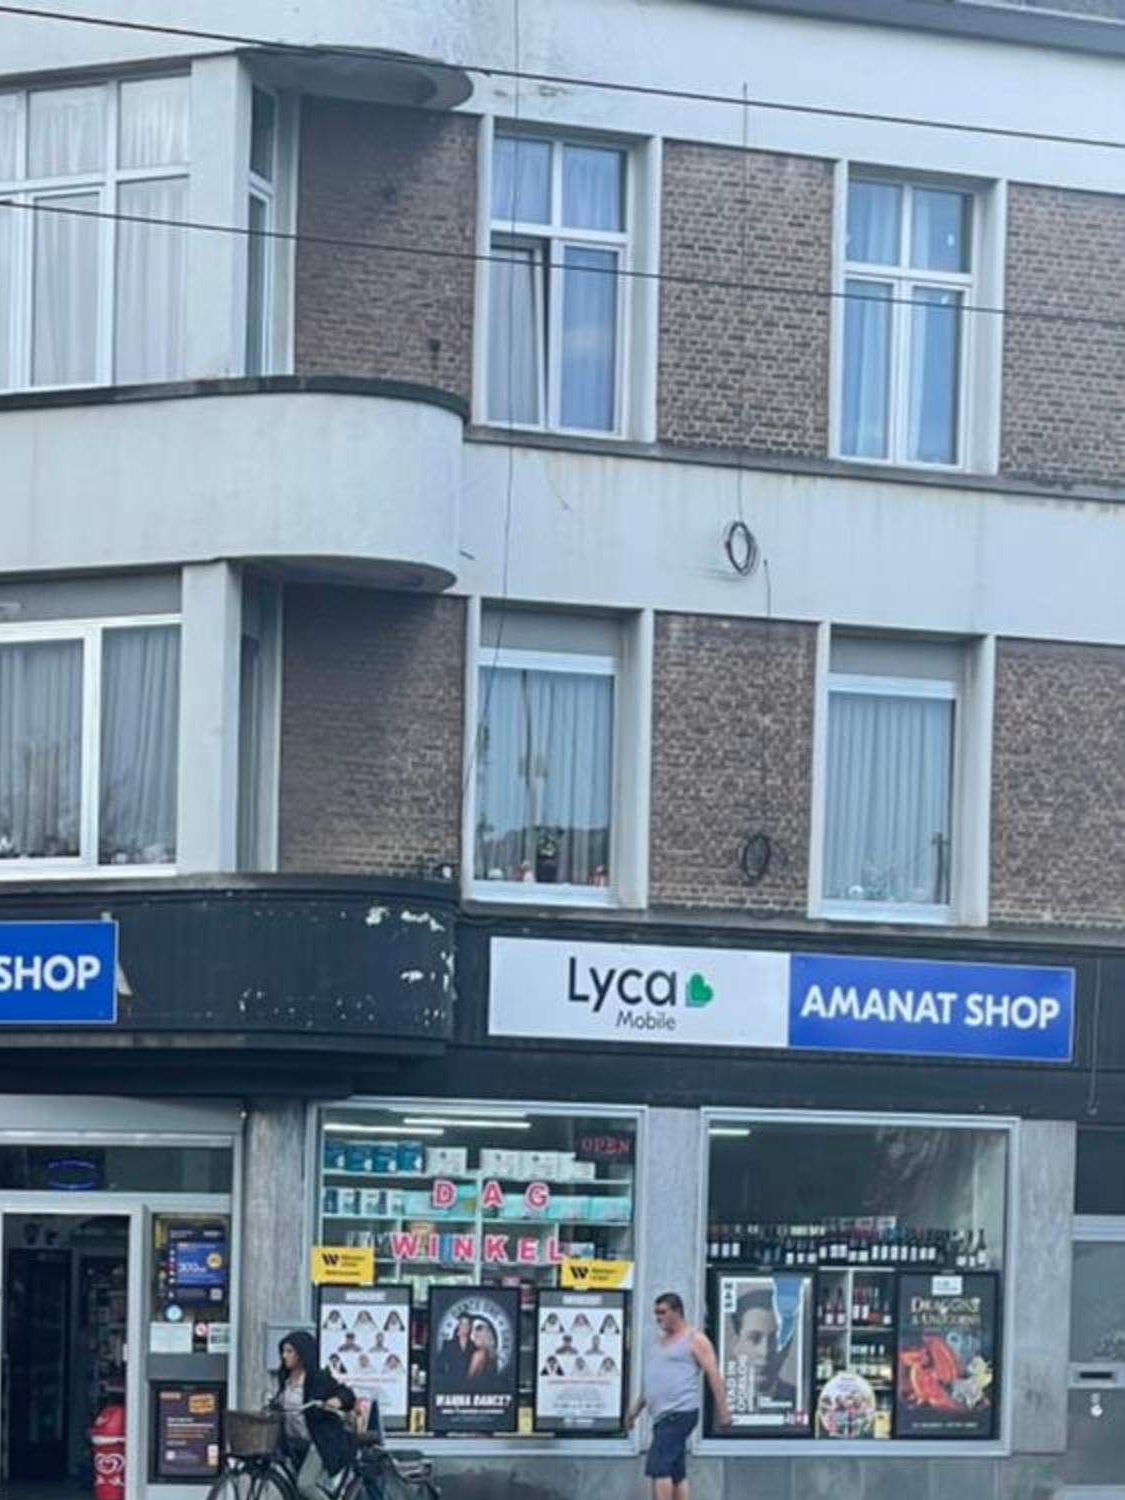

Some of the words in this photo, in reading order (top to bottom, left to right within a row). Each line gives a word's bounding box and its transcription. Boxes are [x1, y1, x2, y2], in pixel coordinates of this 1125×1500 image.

[568, 955, 677, 1012] Lyca
[615, 1010, 676, 1031] Mobile
[800, 984, 958, 1025] AMANAT
[963, 993, 1060, 1030] SHOP
[390, 1230, 567, 1265] WINKEL
